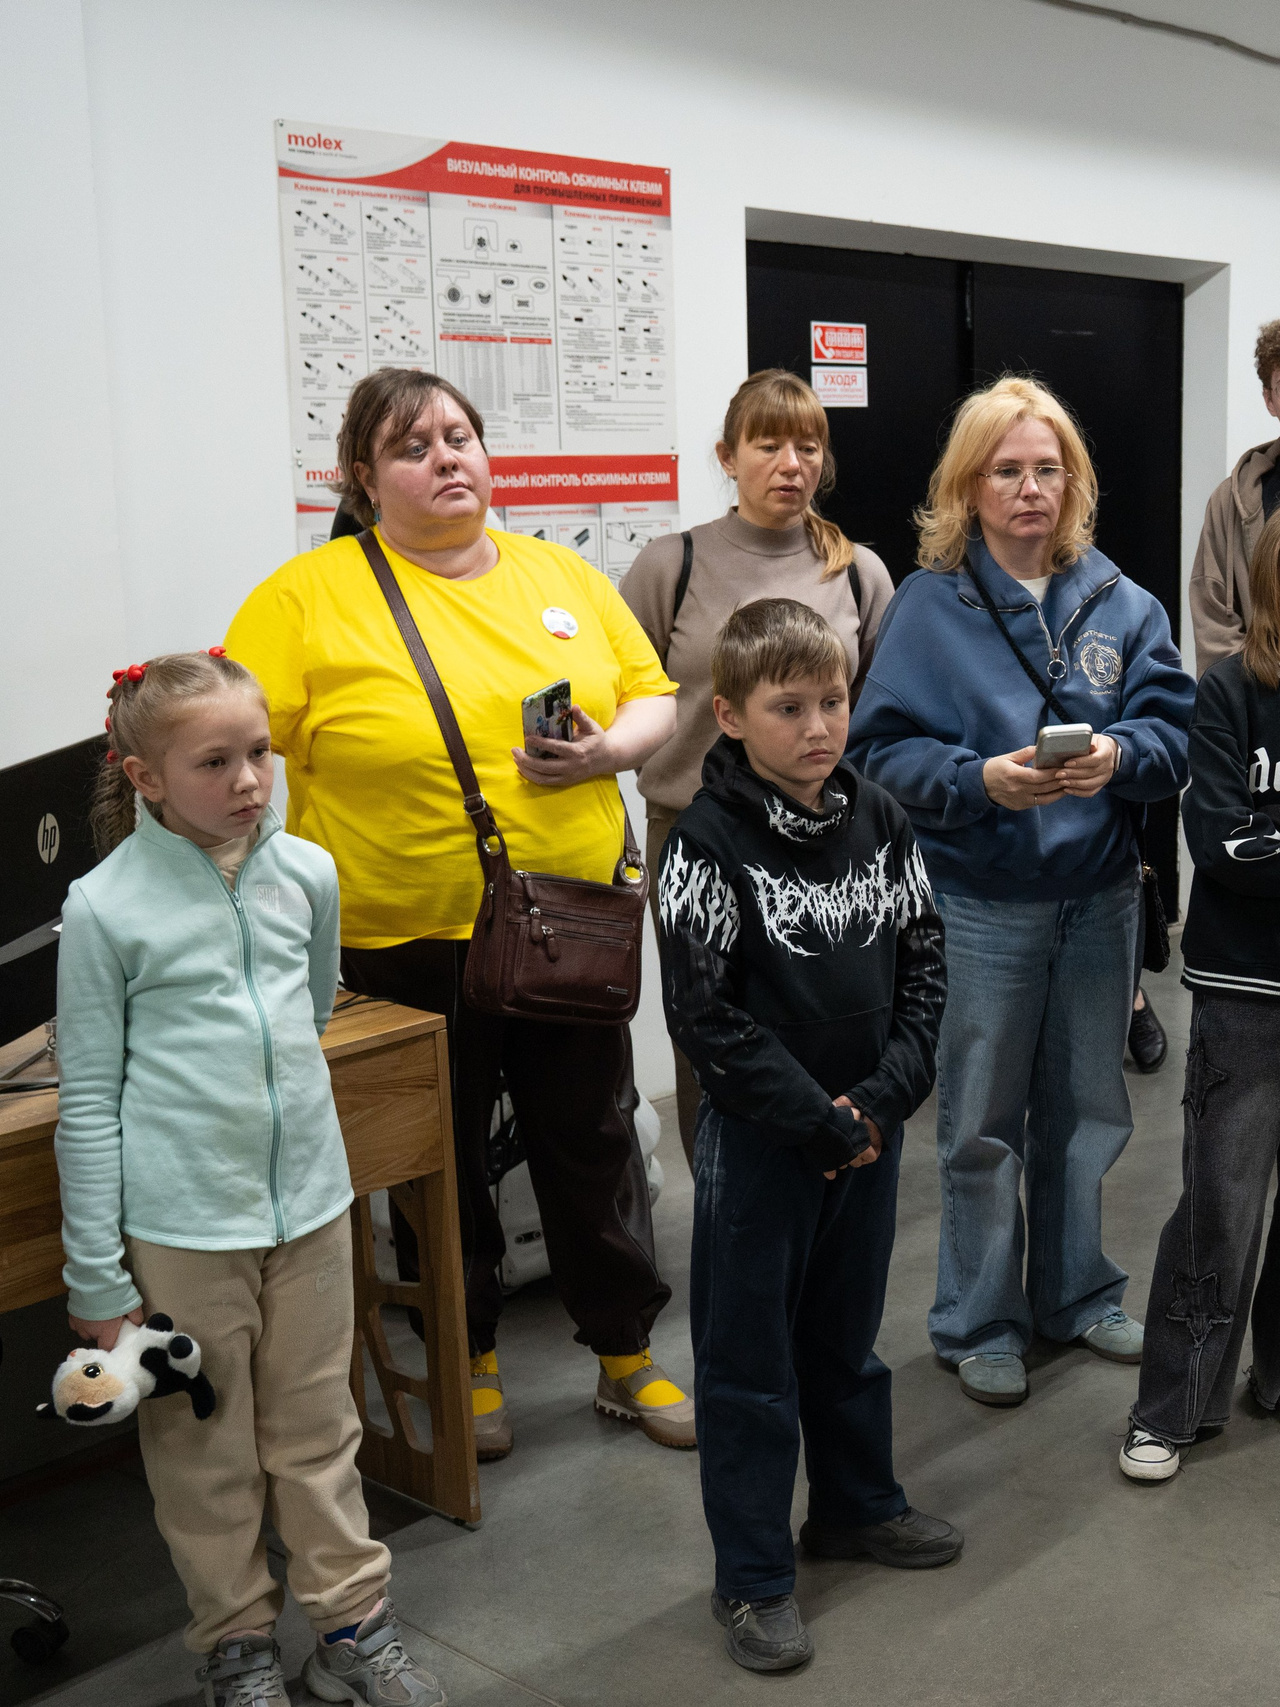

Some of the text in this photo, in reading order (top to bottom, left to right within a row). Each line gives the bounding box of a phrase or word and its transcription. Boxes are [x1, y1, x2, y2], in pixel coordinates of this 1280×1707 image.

[287, 133, 343, 151] molex
[447, 157, 663, 195] ВИЗУАЛЬНЫЙ КОНТРОЛЬ ОБЖИМНЫХ КЛЕММ
[514, 183, 531, 194] ДЛЯ
[533, 185, 608, 202] ПРОМЫШЛЕННЫХ
[823, 374, 858, 386] УХОДЯ
[306, 466, 344, 481] mol
[490, 471, 670, 489] АЛЬНЫЙ КОНТРОЛЬ ОБЖИМНЫХ КЛЕММ
[40, 813, 58, 864] hp
